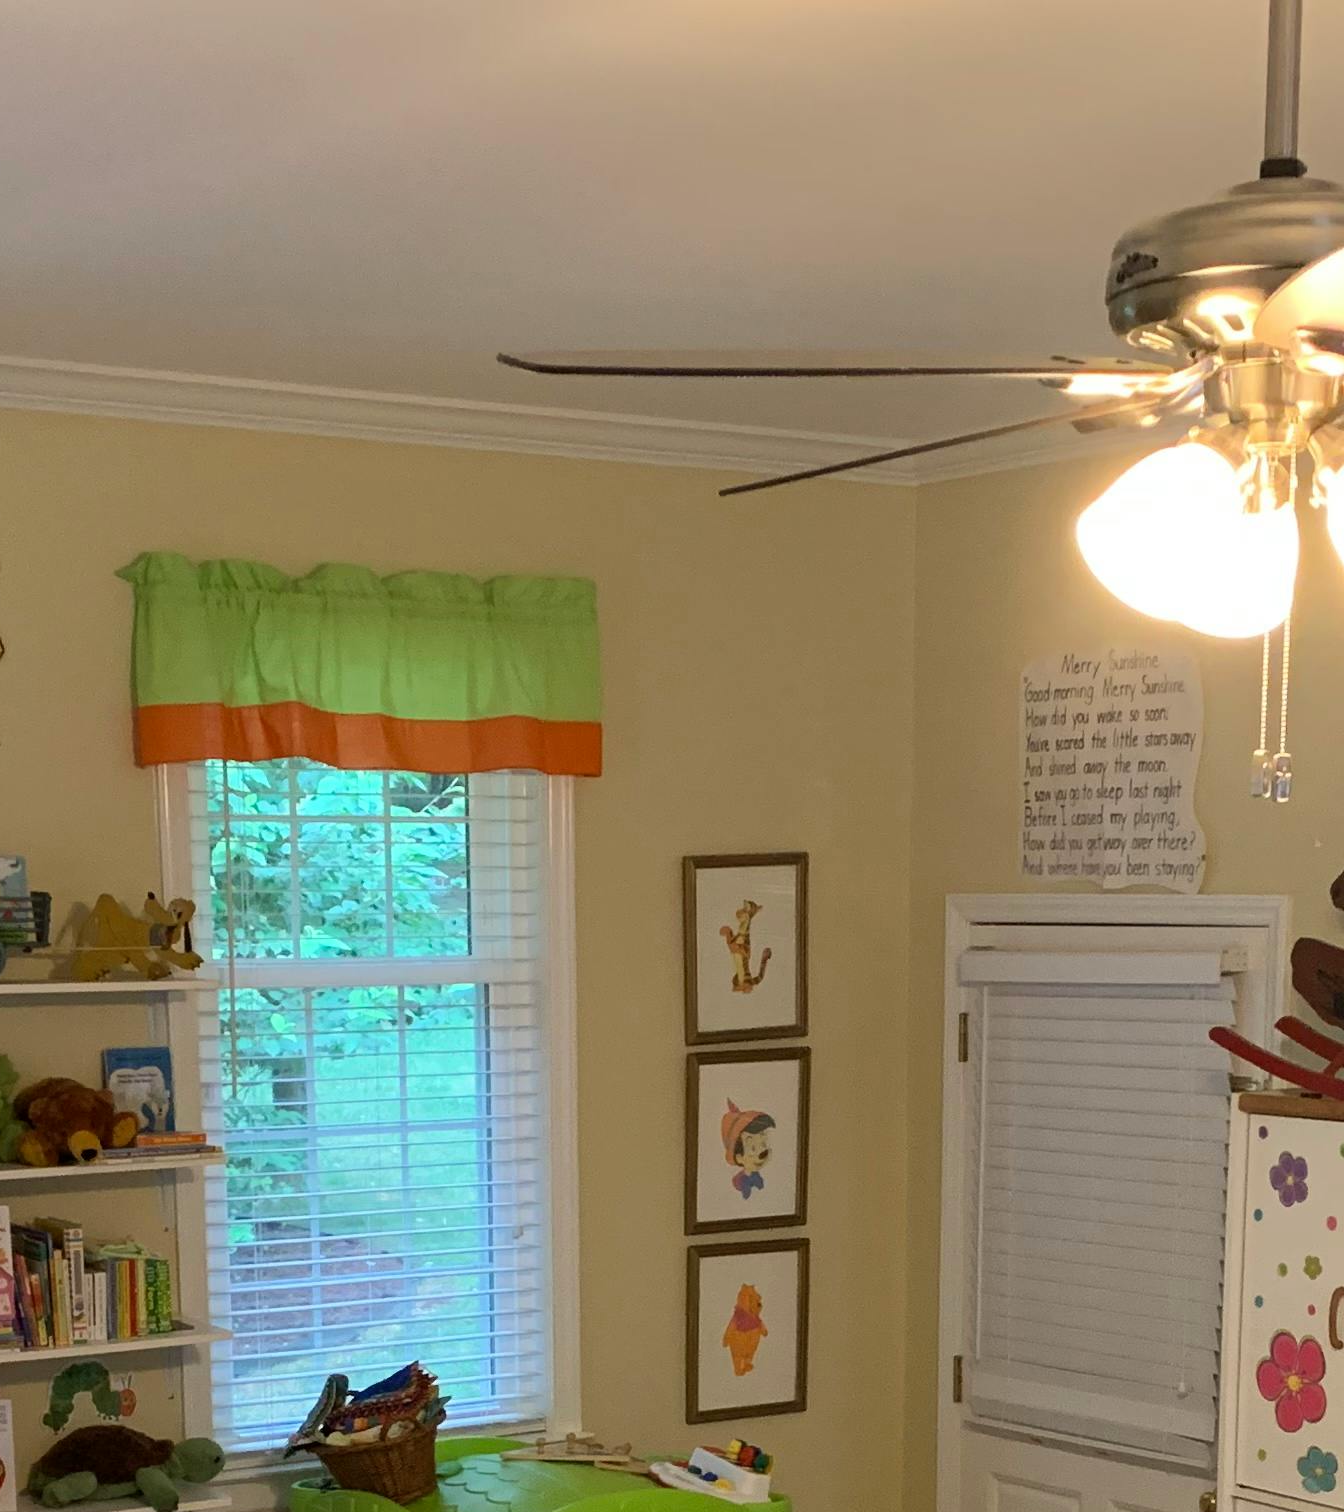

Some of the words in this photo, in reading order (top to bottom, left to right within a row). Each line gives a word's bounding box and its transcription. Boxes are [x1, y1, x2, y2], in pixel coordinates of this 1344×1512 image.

[1061, 653, 1101, 679] Merry
[1109, 648, 1160, 670] Sunshine
[1053, 685, 1094, 705] morning
[1103, 676, 1136, 703] Merry
[1025, 705, 1047, 727] How
[1051, 705, 1067, 725] did
[1072, 711, 1089, 730] you
[1097, 703, 1122, 723] wake
[1129, 709, 1140, 722] so
[1056, 730, 1084, 751] scared
[1091, 729, 1106, 749] the
[1113, 726, 1138, 748] little
[1145, 731, 1168, 747] stars
[1170, 732, 1196, 752] away
[1025, 756, 1043, 778] And
[1083, 762, 1108, 786] away
[1115, 753, 1131, 773] the
[1023, 781, 1031, 803] I
[1034, 790, 1051, 802] saw
[1054, 789, 1067, 806] you
[1069, 788, 1080, 806] go
[1083, 784, 1093, 800] to
[1097, 780, 1123, 806] sleep
[1129, 778, 1149, 799] last
[1153, 776, 1182, 805] night
[1024, 805, 1057, 827] Before
[1060, 804, 1067, 826] I
[1071, 804, 1104, 826] ceased
[1110, 813, 1127, 831] my
[1023, 831, 1045, 850] How
[1049, 831, 1065, 850] did
[1069, 838, 1083, 856] you
[1087, 834, 1102, 857] get
[1103, 837, 1127, 856] way
[1131, 837, 1154, 850] over
[1156, 830, 1196, 851] there?
[1023, 854, 1044, 876] And
[1047, 855, 1078, 875] where
[1103, 862, 1121, 878] you
[1127, 854, 1150, 876] been
